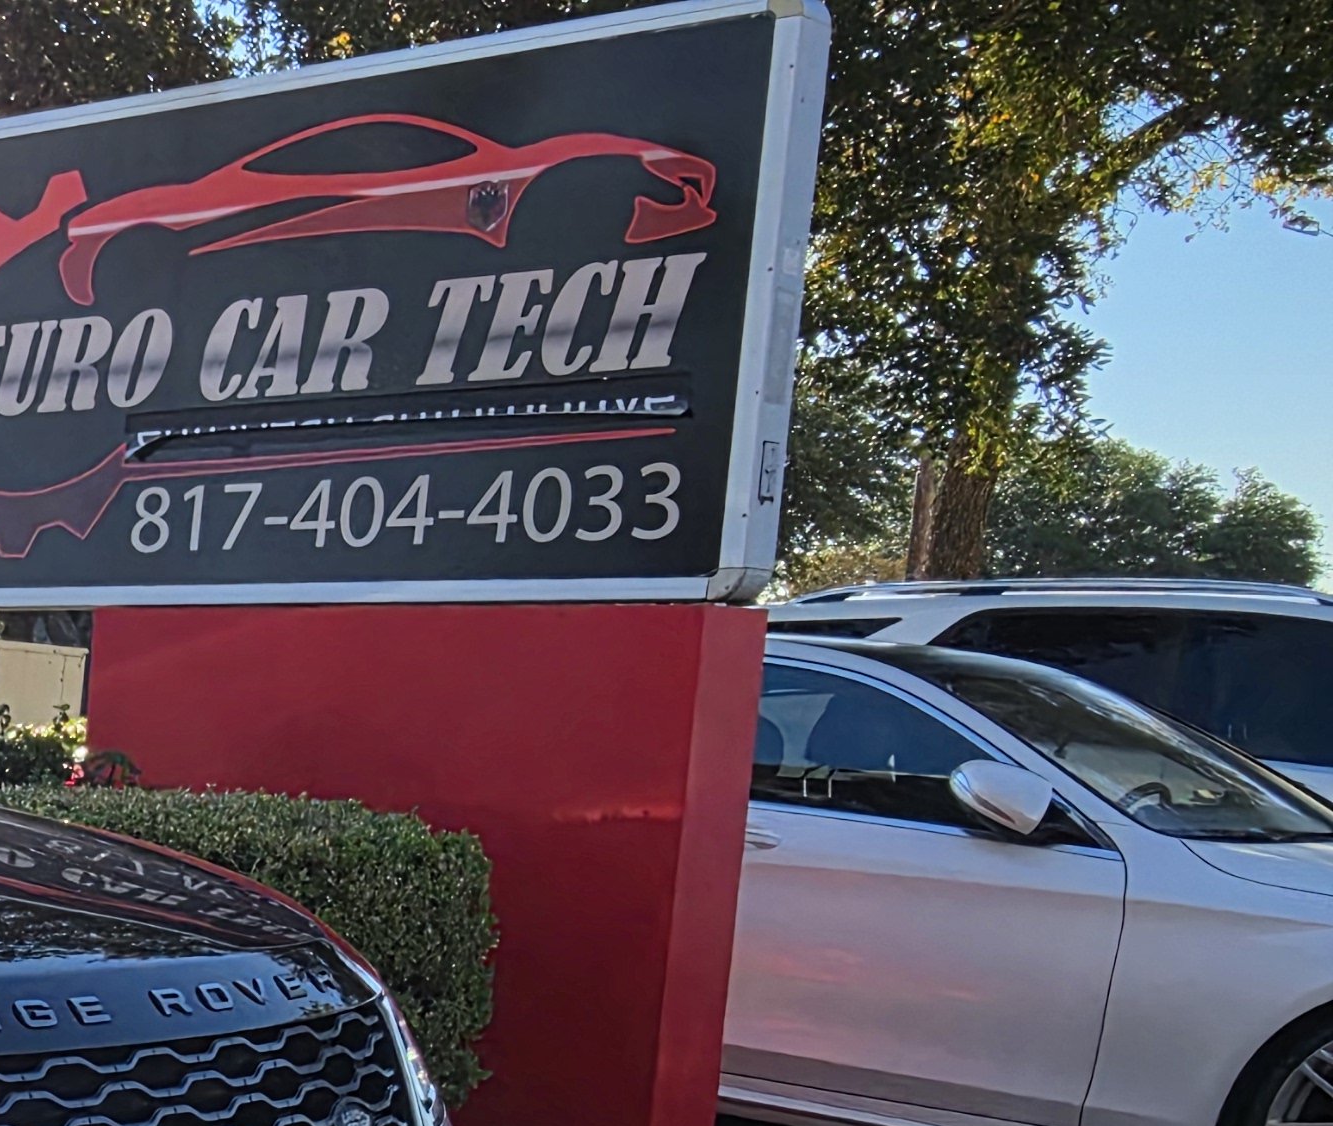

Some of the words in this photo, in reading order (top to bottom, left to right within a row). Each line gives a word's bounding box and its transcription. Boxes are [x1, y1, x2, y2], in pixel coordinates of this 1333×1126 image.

[199, 287, 390, 402] CAR
[416, 252, 708, 387] TECH
[130, 461, 683, 554] 817-404-4033
[150, 967, 340, 1016] ROVER
